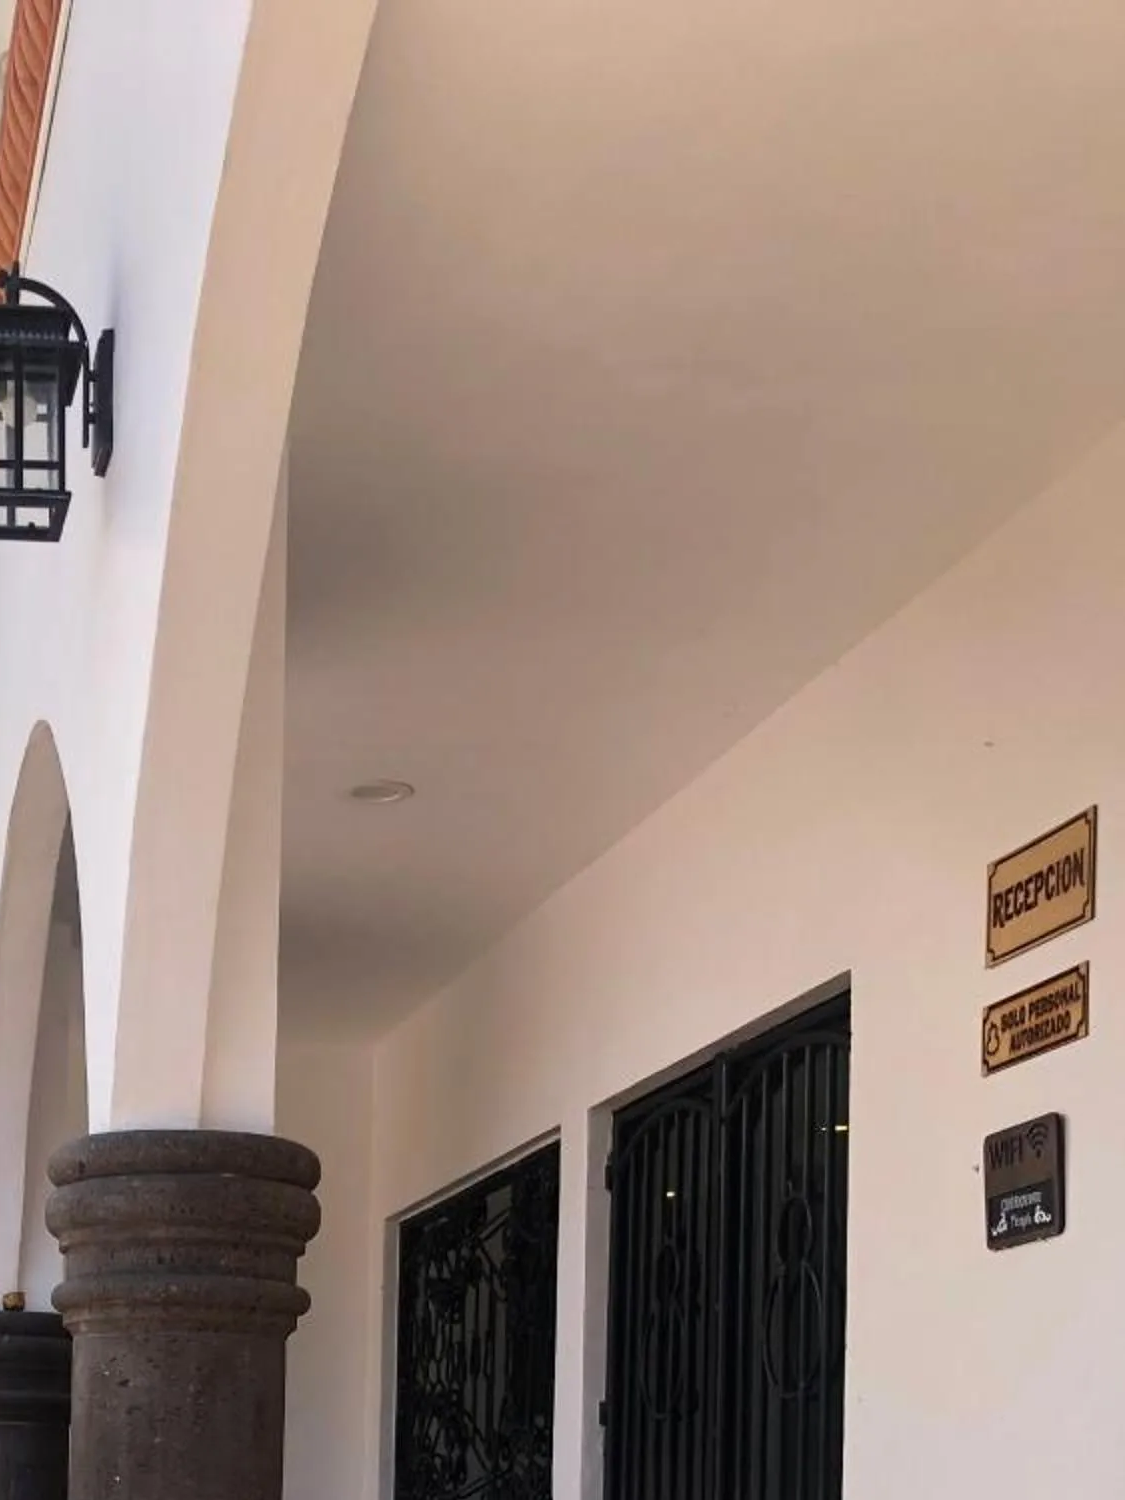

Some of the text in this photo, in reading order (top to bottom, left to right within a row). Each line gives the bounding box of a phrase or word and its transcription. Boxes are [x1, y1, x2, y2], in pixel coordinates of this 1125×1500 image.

[1000, 981, 1081, 1033] SOLO PERSONAL
[1009, 1009, 1071, 1051] AUTORIZADO
[987, 1132, 1023, 1171] WIFI
